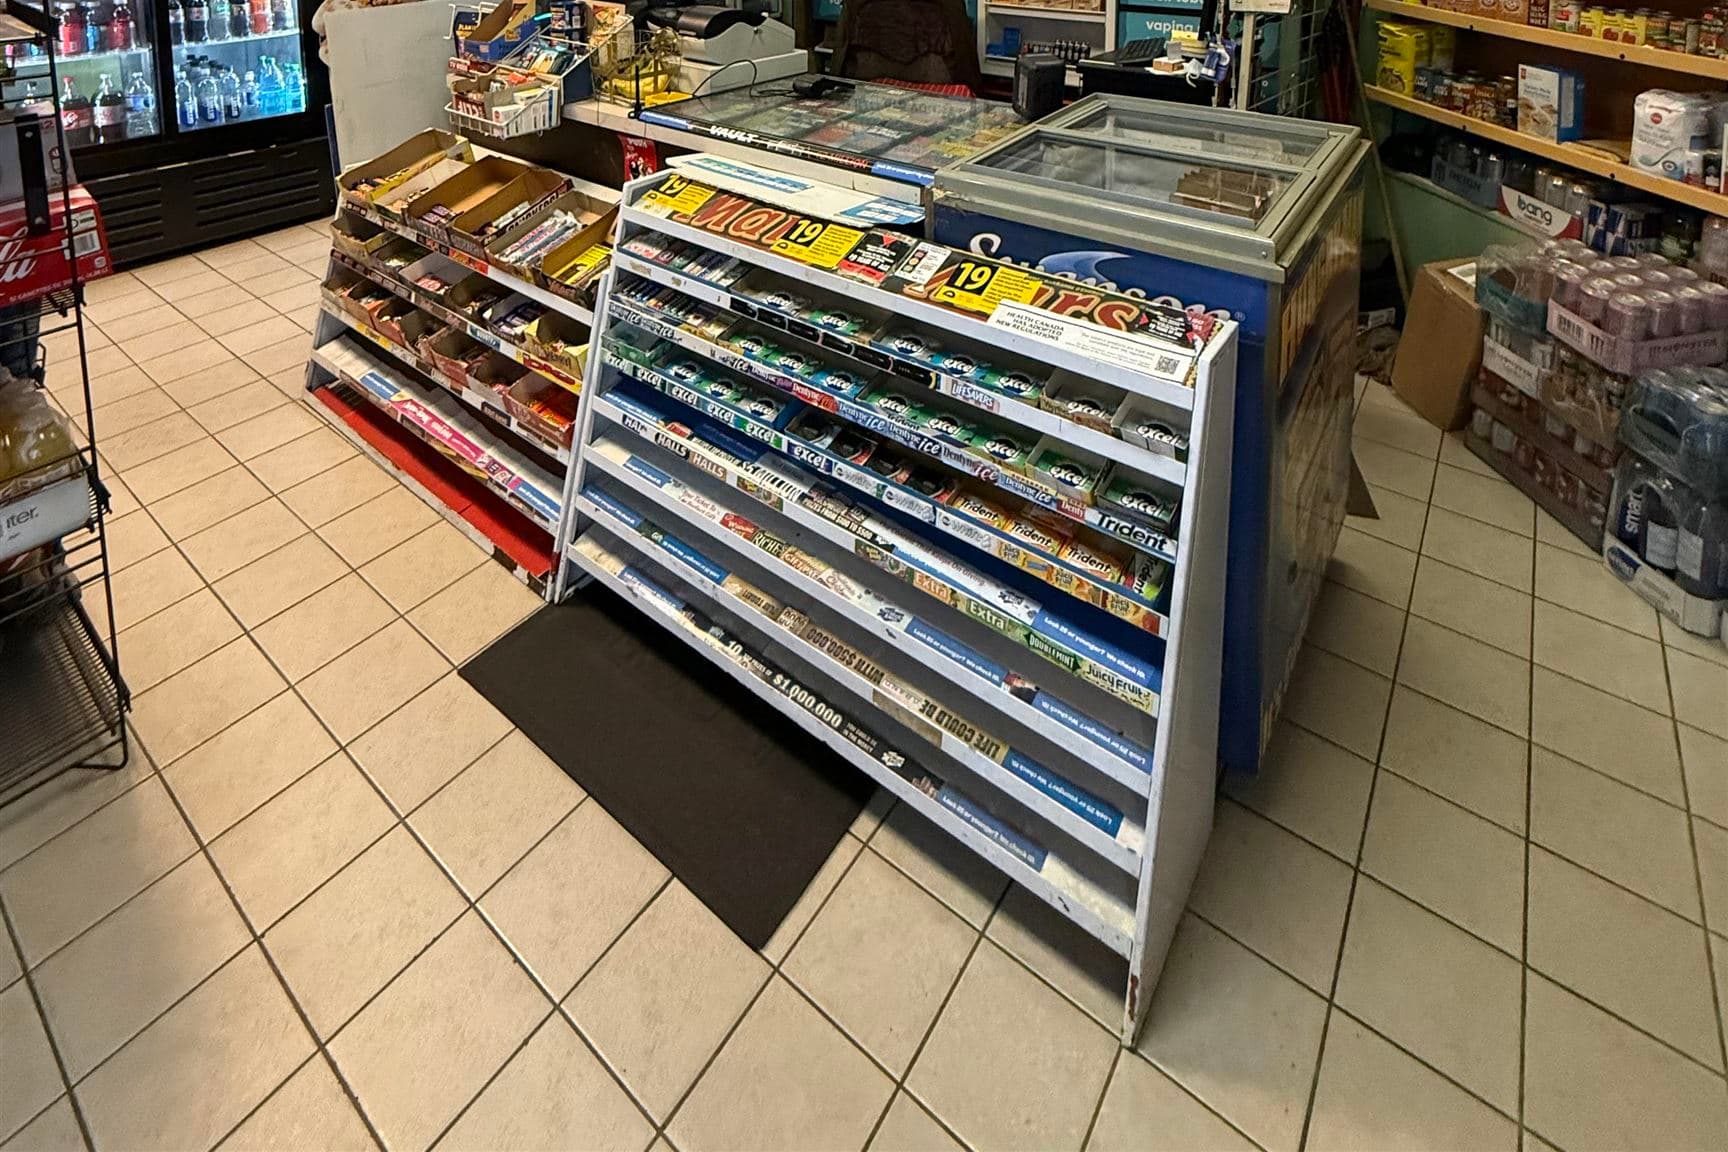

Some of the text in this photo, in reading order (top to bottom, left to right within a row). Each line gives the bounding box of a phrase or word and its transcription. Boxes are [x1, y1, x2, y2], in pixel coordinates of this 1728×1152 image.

[1146, 19, 1194, 34] vaping
[710, 125, 757, 143] VAULT
[658, 173, 688, 194] 19
[1516, 193, 1553, 227] bang
[788, 219, 824, 244] 19
[952, 261, 993, 291] 19
[995, 319, 1059, 342] NEW REGULATIONS
[1006, 311, 1064, 332] HEALTH CANADA
[1012, 319, 1062, 337] HAS ADOPTED
[779, 355, 805, 370] excel
[944, 358, 977, 375] excel
[637, 367, 662, 387] excel
[825, 375, 855, 391] excel
[1000, 375, 1035, 393] excel
[671, 385, 698, 406] excel
[793, 382, 820, 402] Dentyne
[952, 380, 994, 408] LIFESAVERS
[707, 402, 735, 424] excel
[839, 402, 886, 431] Dentyne ice
[878, 397, 910, 415] excel
[1067, 400, 1106, 418] excel
[745, 421, 776, 443] excel
[928, 417, 960, 436] excel
[1137, 425, 1180, 447] excel
[657, 432, 687, 457] HALLS
[890, 423, 941, 455] Dentyne ice
[984, 438, 1021, 459] excel
[693, 453, 724, 478] HALLS
[794, 445, 826, 469] excel
[943, 447, 999, 482] Dentyne ice
[1050, 464, 1089, 487] excel
[1005, 477, 1052, 504] Dentyne ice
[961, 499, 999, 522] Trident
[1120, 493, 1164, 518] excel
[1624, 489, 1643, 534] smart
[857, 526, 873, 540] $500
[1012, 521, 1052, 547] Trident
[1098, 511, 1169, 552] Trident
[1067, 547, 1112, 573] Trident
[916, 573, 948, 601] Extra
[969, 598, 1005, 631] Extra
[728, 639, 743, 654] 10
[806, 628, 885, 686] WITH $500,000
[1029, 633, 1075, 670] DOUBLEMINT
[919, 698, 1001, 759] LIFE COULD BE
